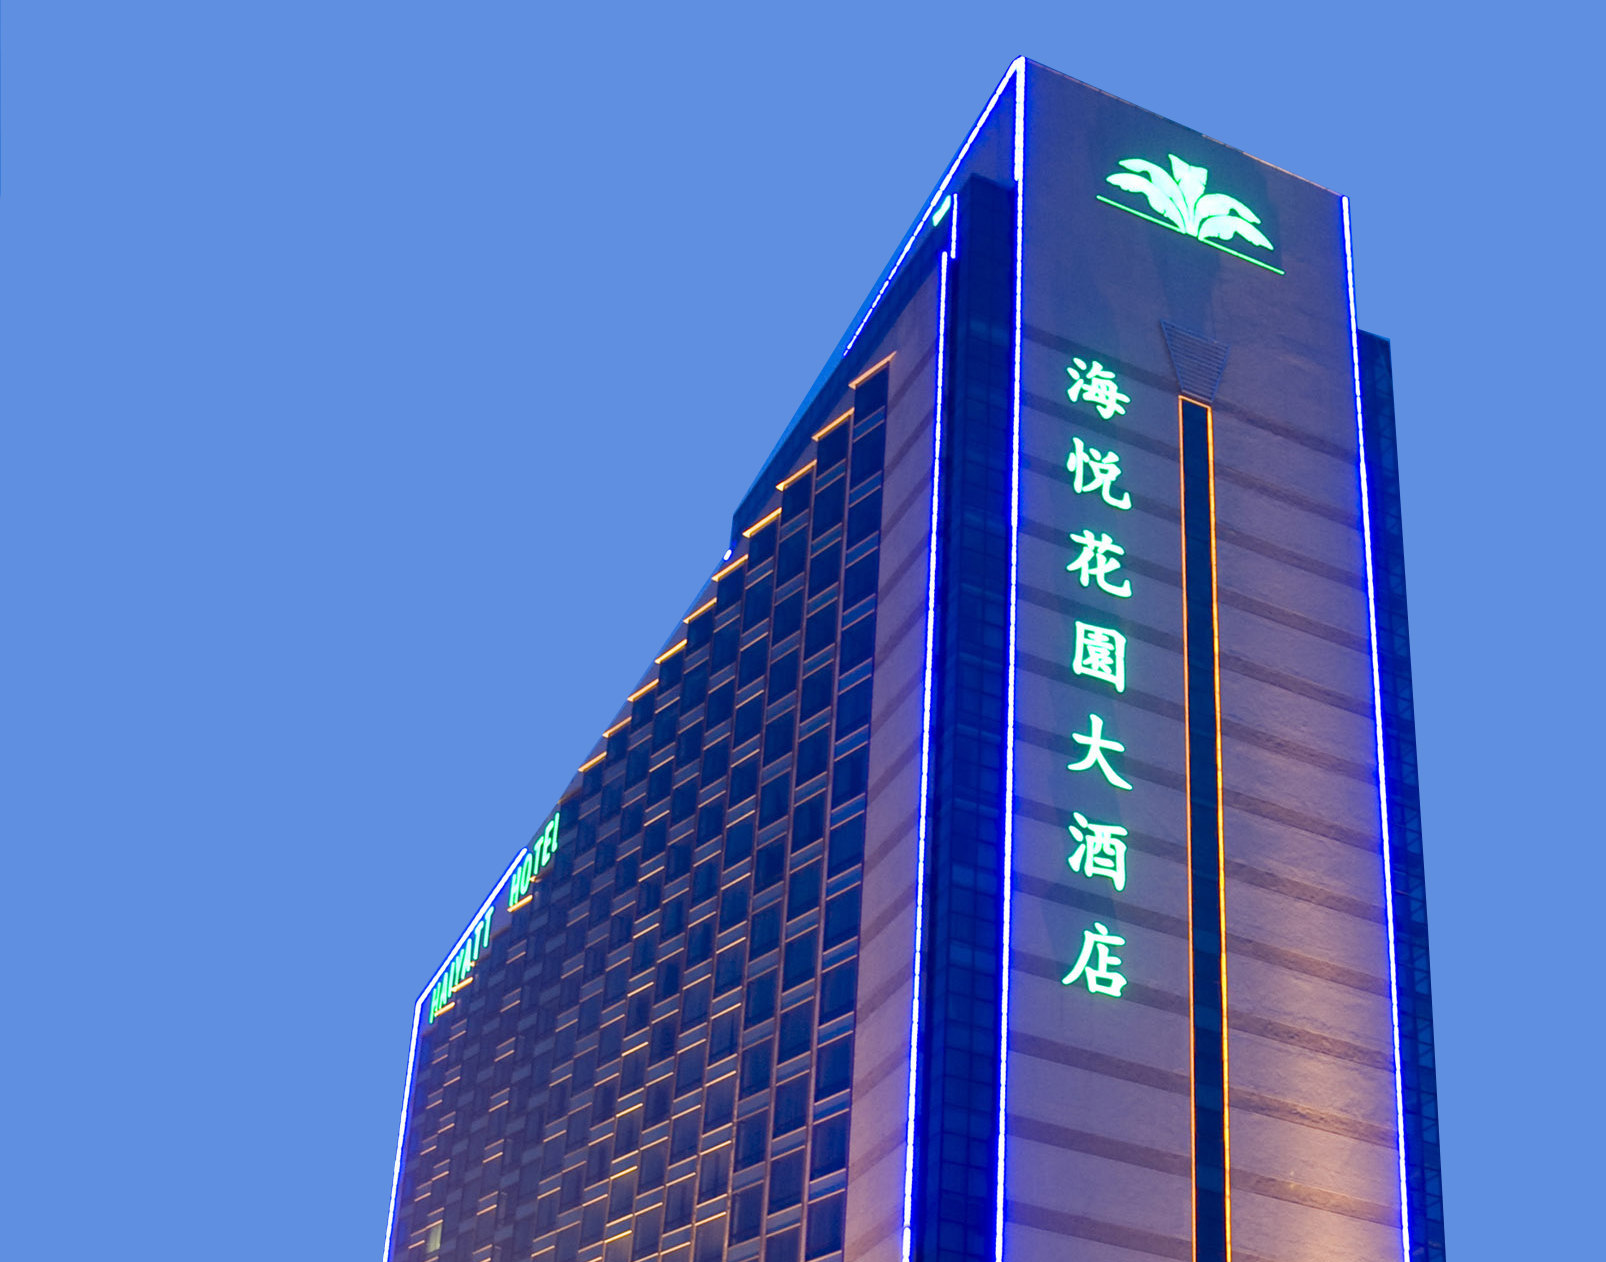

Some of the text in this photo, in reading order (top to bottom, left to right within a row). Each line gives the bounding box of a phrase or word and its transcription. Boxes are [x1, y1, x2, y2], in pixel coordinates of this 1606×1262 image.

[508, 812, 560, 907] HOTEL
[1062, 357, 1133, 998] 海悦花園大酒店
